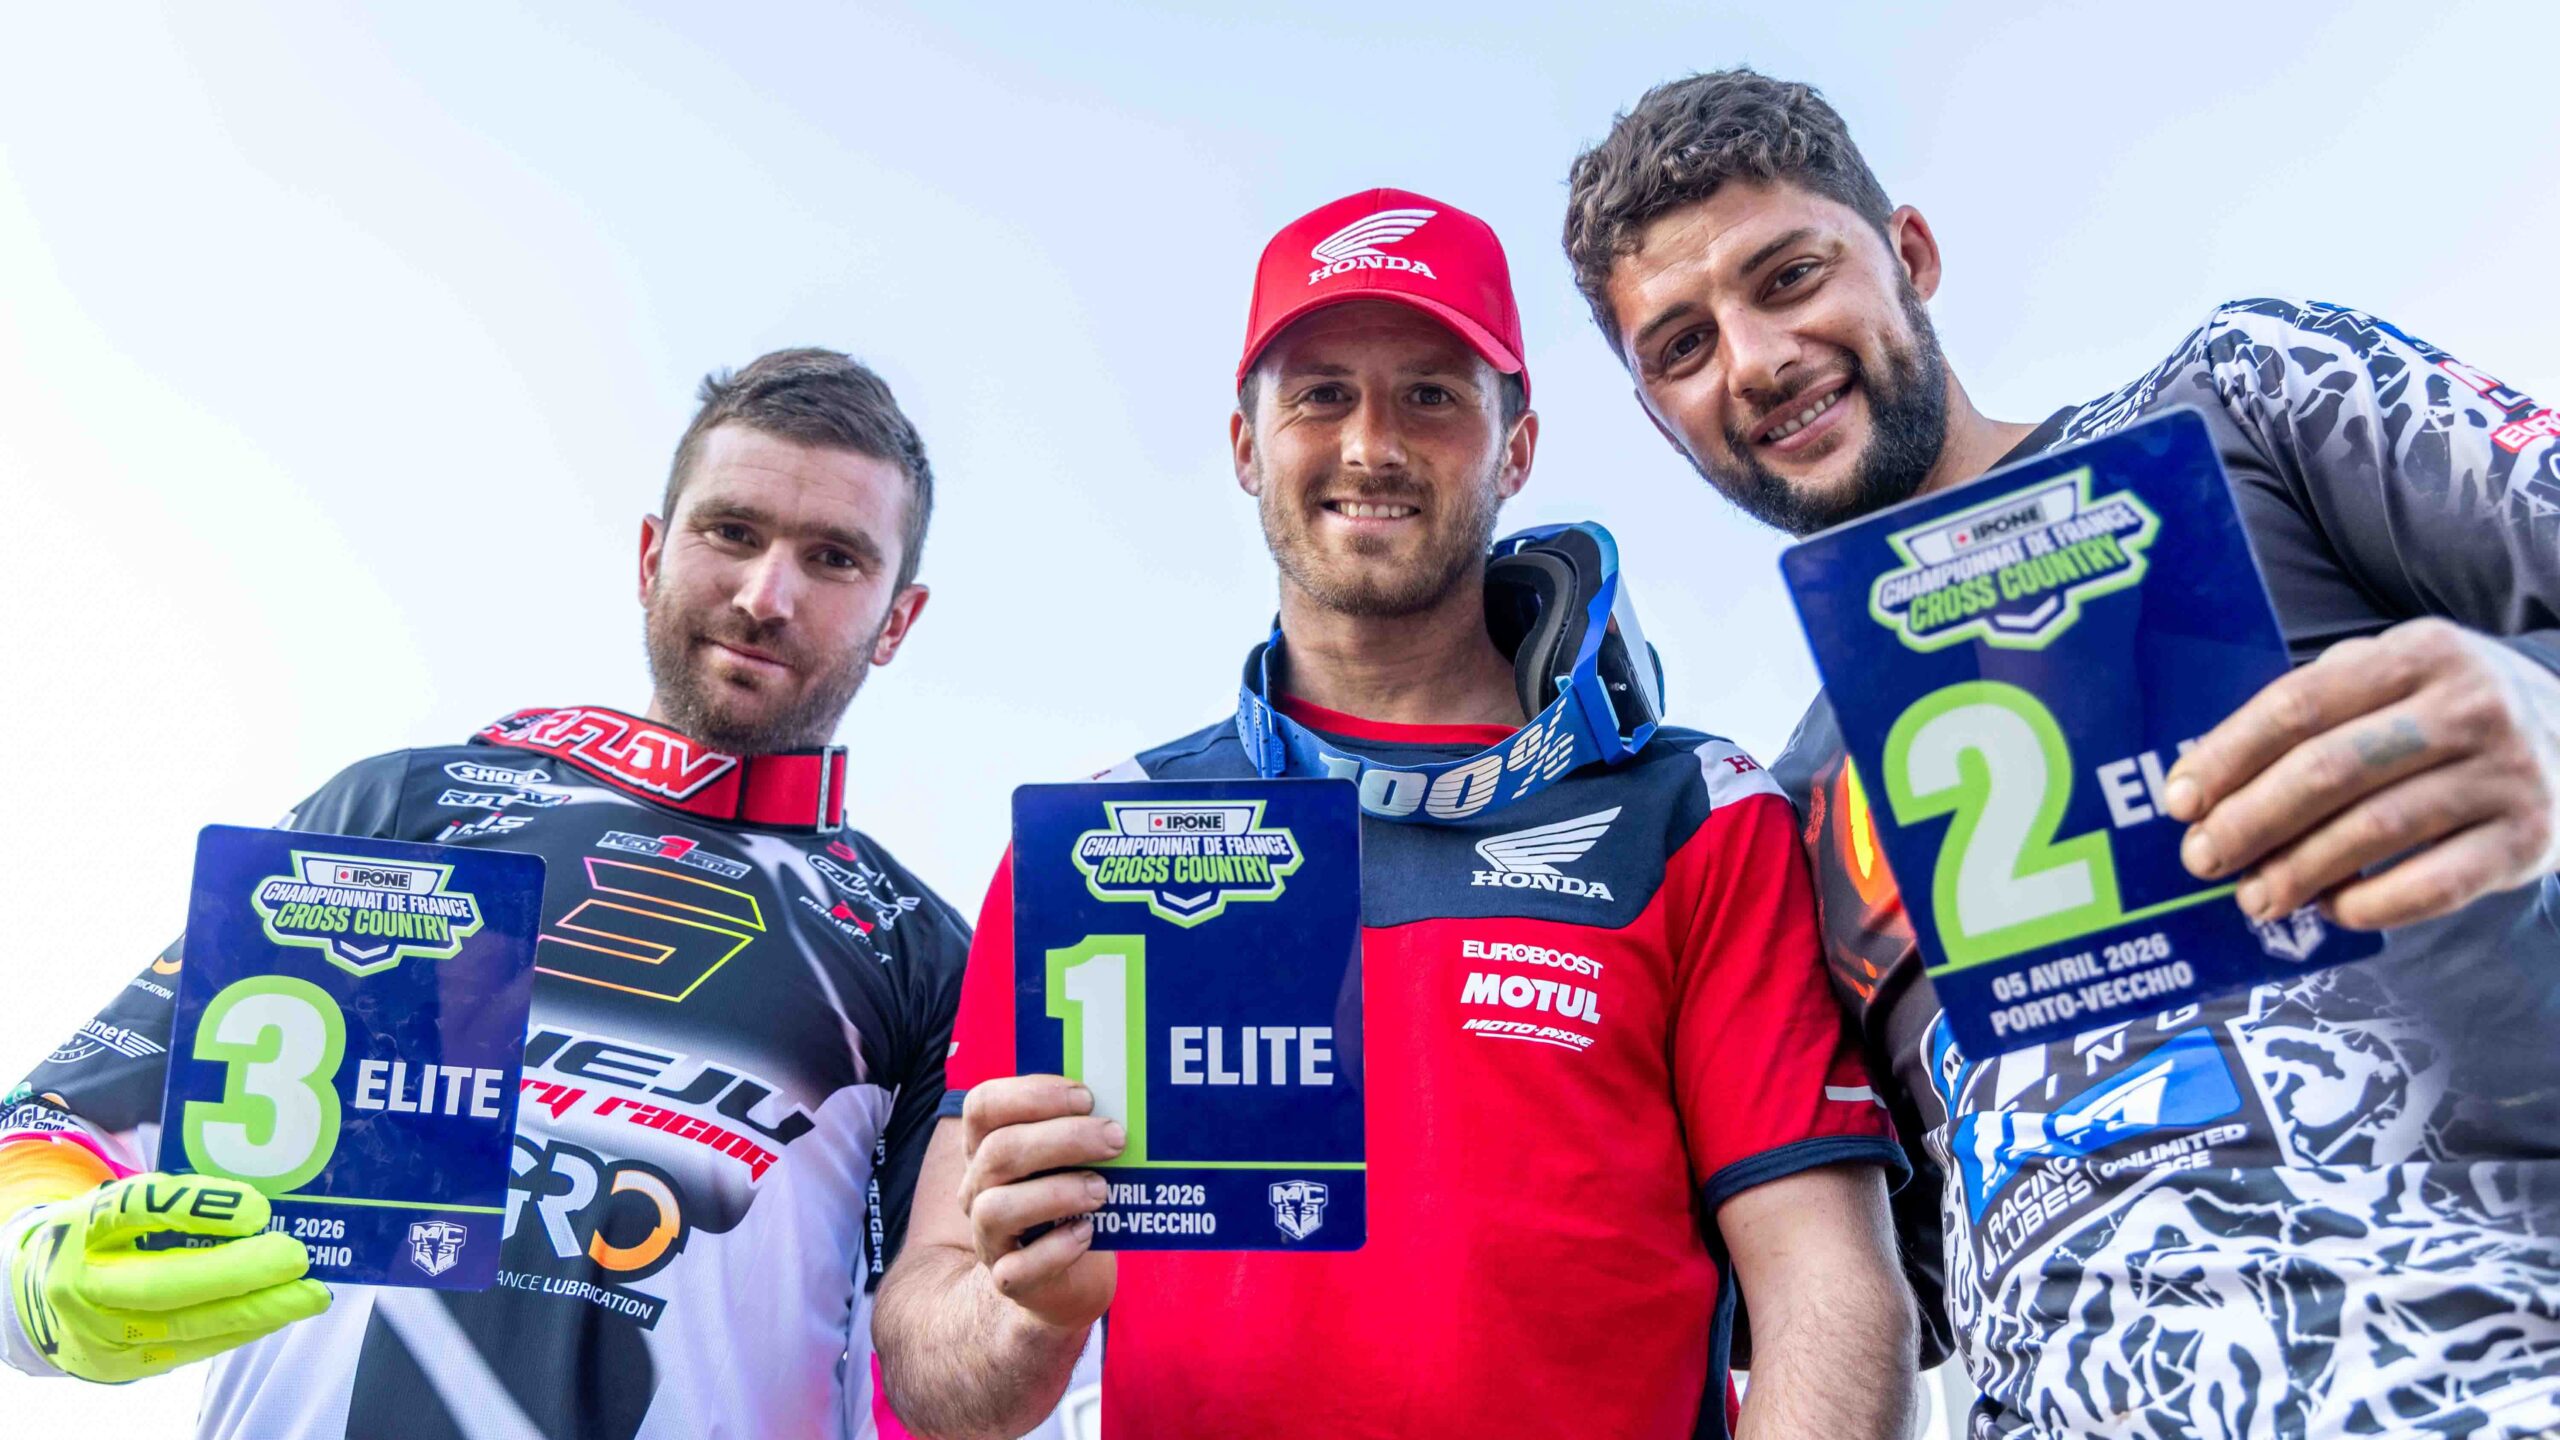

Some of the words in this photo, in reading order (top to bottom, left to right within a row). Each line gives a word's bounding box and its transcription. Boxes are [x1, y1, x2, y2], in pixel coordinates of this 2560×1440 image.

[1308, 255, 1437, 285] HONDA
[1973, 508, 2040, 541] IPONE
[1882, 537, 2025, 607] CHAMPIONNAT
[2022, 528, 2056, 556] DE
[2051, 504, 2141, 546] FRANCE
[1910, 573, 1998, 632] CROSS
[1999, 534, 2127, 600] COUNTRY
[1319, 697, 1575, 820] 100%
[1166, 815, 1222, 829] IPONE
[1887, 686, 2117, 957] 2
[1083, 836, 1201, 857] CHAMPIONNAT
[1203, 836, 1224, 856] DE
[1227, 836, 1291, 856] FRANCE
[352, 869, 410, 888] IPONE
[1097, 855, 1171, 884] CROSS
[1174, 855, 1272, 884] COUNTRY
[1470, 870, 1615, 902] HONDA
[263, 883, 384, 909] CHAMPIONNAT
[387, 894, 407, 912] DE
[409, 896, 472, 918] FRANCE
[275, 902, 350, 933] CROSS
[354, 908, 450, 941] COUNTRY
[1462, 939, 1604, 979] EUROBOOST
[1991, 972, 2029, 1002] 05
[2029, 950, 2106, 994] AVRIL
[2103, 932, 2170, 973] 2026
[1460, 971, 1602, 1024] MOTUL
[1989, 960, 2195, 1037] PORTO-VECCHIO
[1050, 939, 1143, 1162] 1
[1462, 1018, 1595, 1048] MOTO-AXXE
[1169, 1026, 1335, 1086] ELITE
[189, 981, 340, 1188] 3
[354, 1059, 504, 1119] ELITE
[1102, 1183, 1152, 1206] VRIL
[1155, 1184, 1206, 1206] 2026
[1988, 1157, 2078, 1243] RACING
[295, 1217, 345, 1239] 2026
[1995, 1175, 2092, 1266] LUBES
[542, 1277, 654, 1319] LUBRICATION
